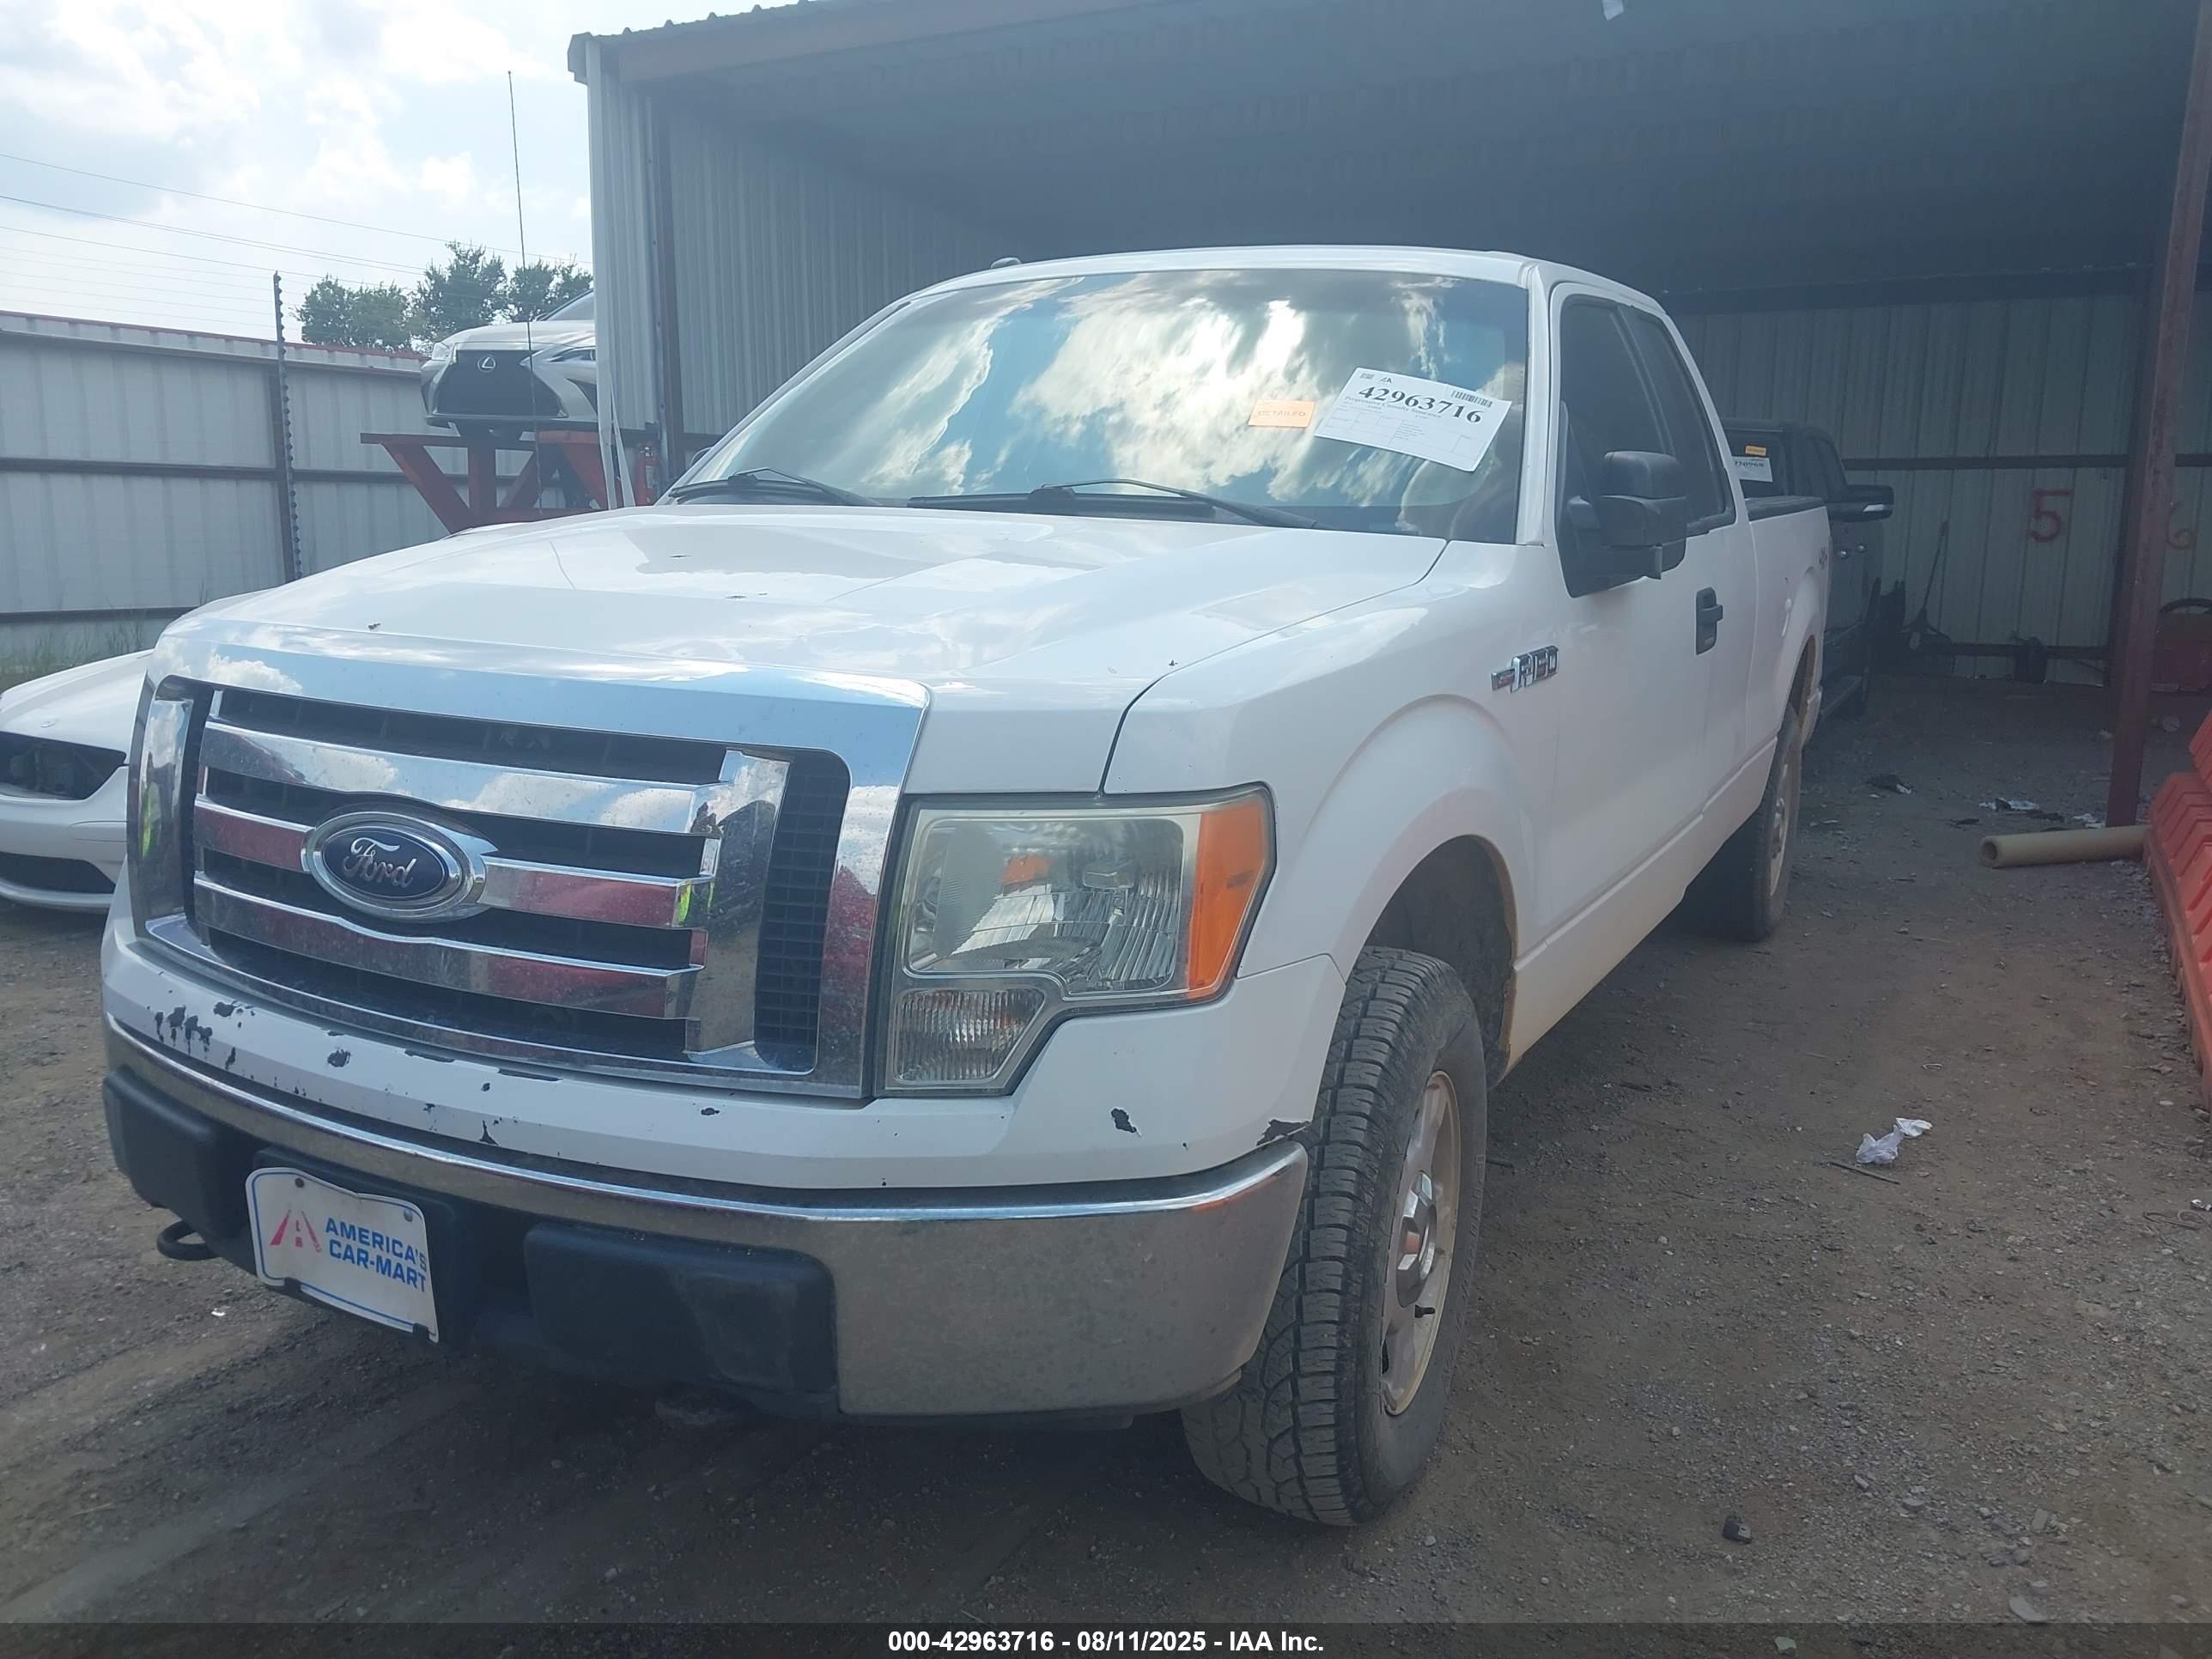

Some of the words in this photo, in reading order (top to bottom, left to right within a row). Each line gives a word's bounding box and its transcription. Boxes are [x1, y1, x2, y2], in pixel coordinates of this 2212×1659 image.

[1358, 386, 1485, 423] 42963716
[2027, 489, 2075, 544] 5
[343, 836, 418, 888] Ford
[325, 1217, 428, 1273] AMERICA'S
[329, 1238, 427, 1292] CAR-MART
